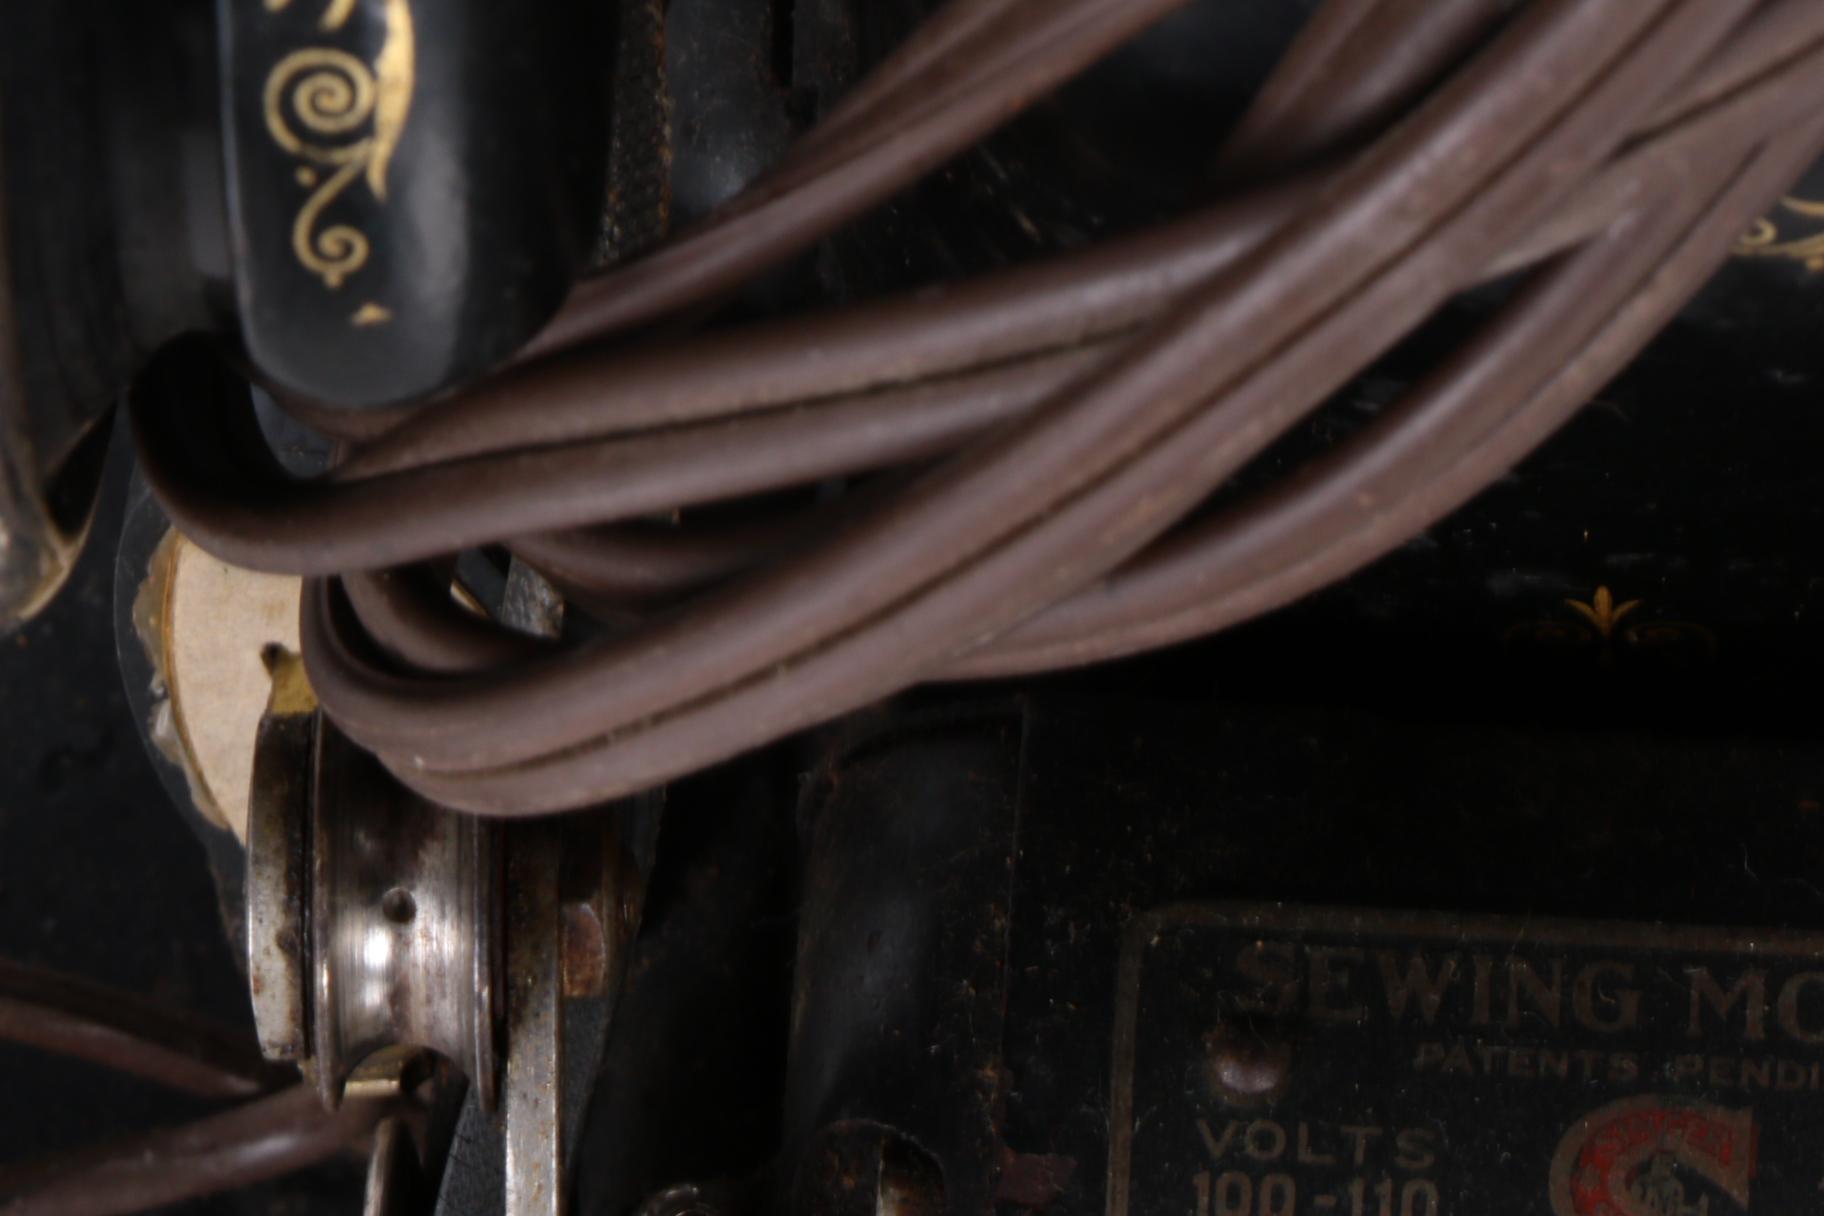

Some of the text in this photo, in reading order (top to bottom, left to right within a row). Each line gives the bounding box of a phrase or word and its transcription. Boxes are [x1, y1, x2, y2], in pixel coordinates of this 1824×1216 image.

[1235, 939, 1643, 1035] SEWING
[1416, 1039, 1639, 1082] PATENTS
[1196, 1118, 1439, 1170] VOLTS
